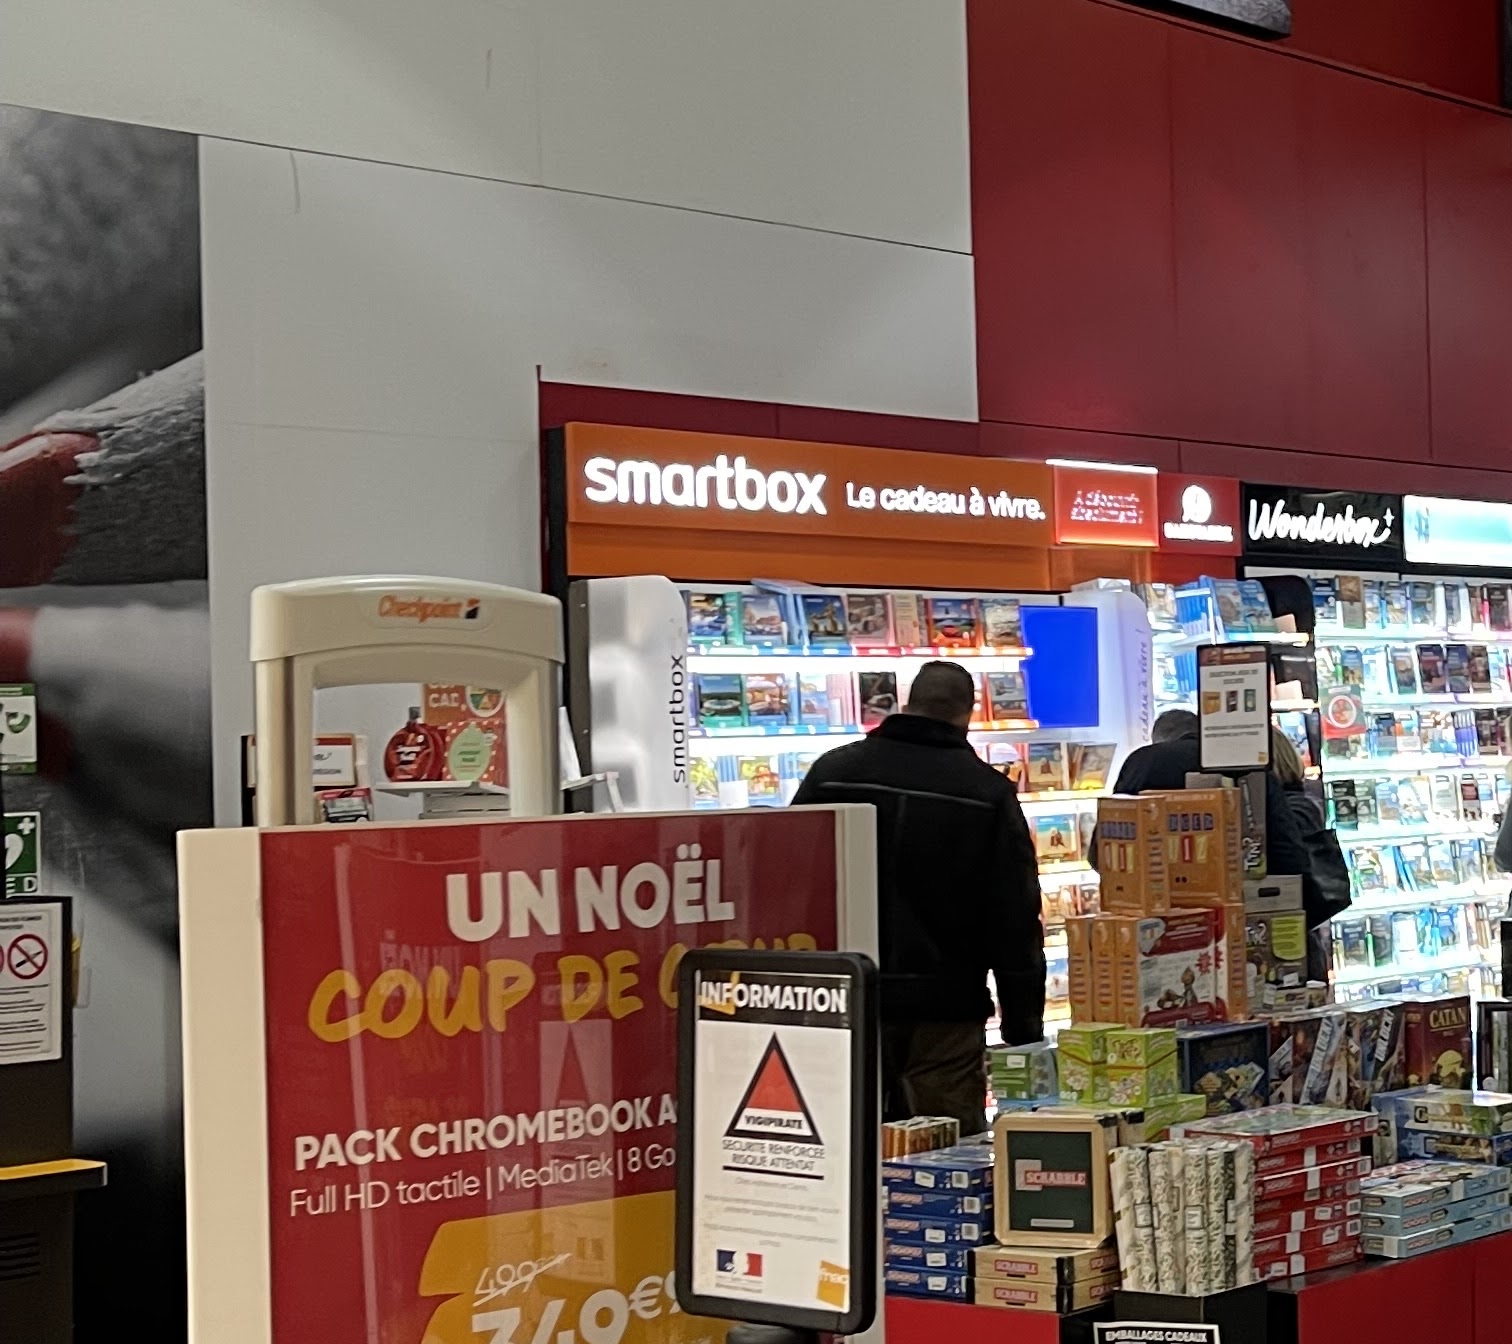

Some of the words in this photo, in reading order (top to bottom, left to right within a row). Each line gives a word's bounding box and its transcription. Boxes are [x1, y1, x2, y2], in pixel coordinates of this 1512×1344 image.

[584, 454, 828, 516] smartbox
[845, 481, 876, 510] Le
[879, 484, 966, 516] cadeau
[968, 486, 986, 517] à
[987, 490, 1047, 522] vivre.
[1248, 498, 1392, 550] Wonderbox
[669, 654, 686, 784] smartbox
[447, 869, 561, 943] UN
[574, 843, 736, 934] NOËL
[308, 958, 537, 1043] COUP
[556, 949, 644, 1024] DE
[700, 981, 848, 1014] INFORMATION
[1429, 1007, 1467, 1027] CATAN
[295, 1126, 402, 1171] PACK
[410, 1095, 655, 1158] CHROMEBOOK
[745, 1114, 803, 1130] VIGIPIRATE
[290, 1181, 337, 1216] Full
[344, 1180, 390, 1211] HD
[397, 1169, 481, 1206] tactile
[498, 1154, 614, 1192] MediaTek
[627, 1146, 642, 1173] 8
[644, 1142, 677, 1169] Go
[1026, 1171, 1087, 1186] SCRABBLE
[995, 1260, 1038, 1274] SCRABBLE
[995, 1288, 1038, 1303] SCRABBLE
[1105, 1329, 1164, 1342] EMBALLAGES
[1164, 1331, 1208, 1343] CADEAUX
